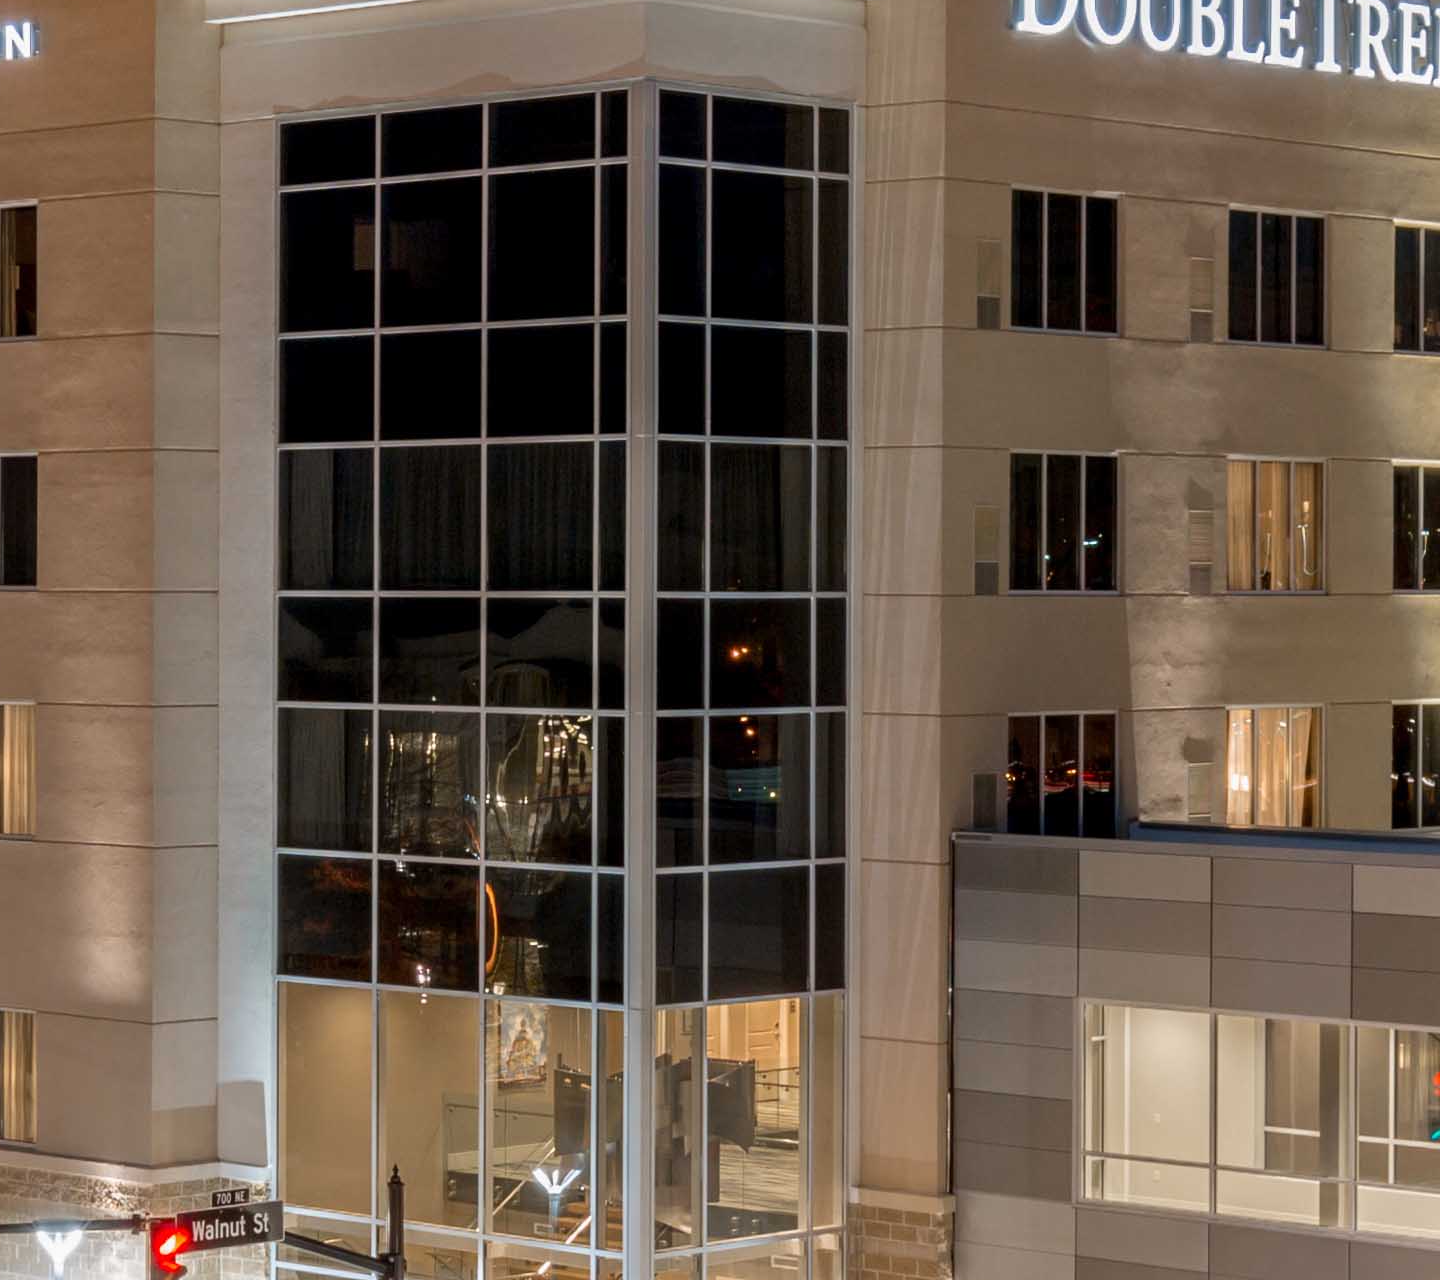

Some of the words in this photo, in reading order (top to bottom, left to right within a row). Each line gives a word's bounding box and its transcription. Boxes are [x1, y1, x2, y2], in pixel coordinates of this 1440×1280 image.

[216, 1193, 232, 1205] 700
[234, 1190, 246, 1202] NE
[192, 1215, 246, 1242] Walnut
[253, 1212, 269, 1234] St
